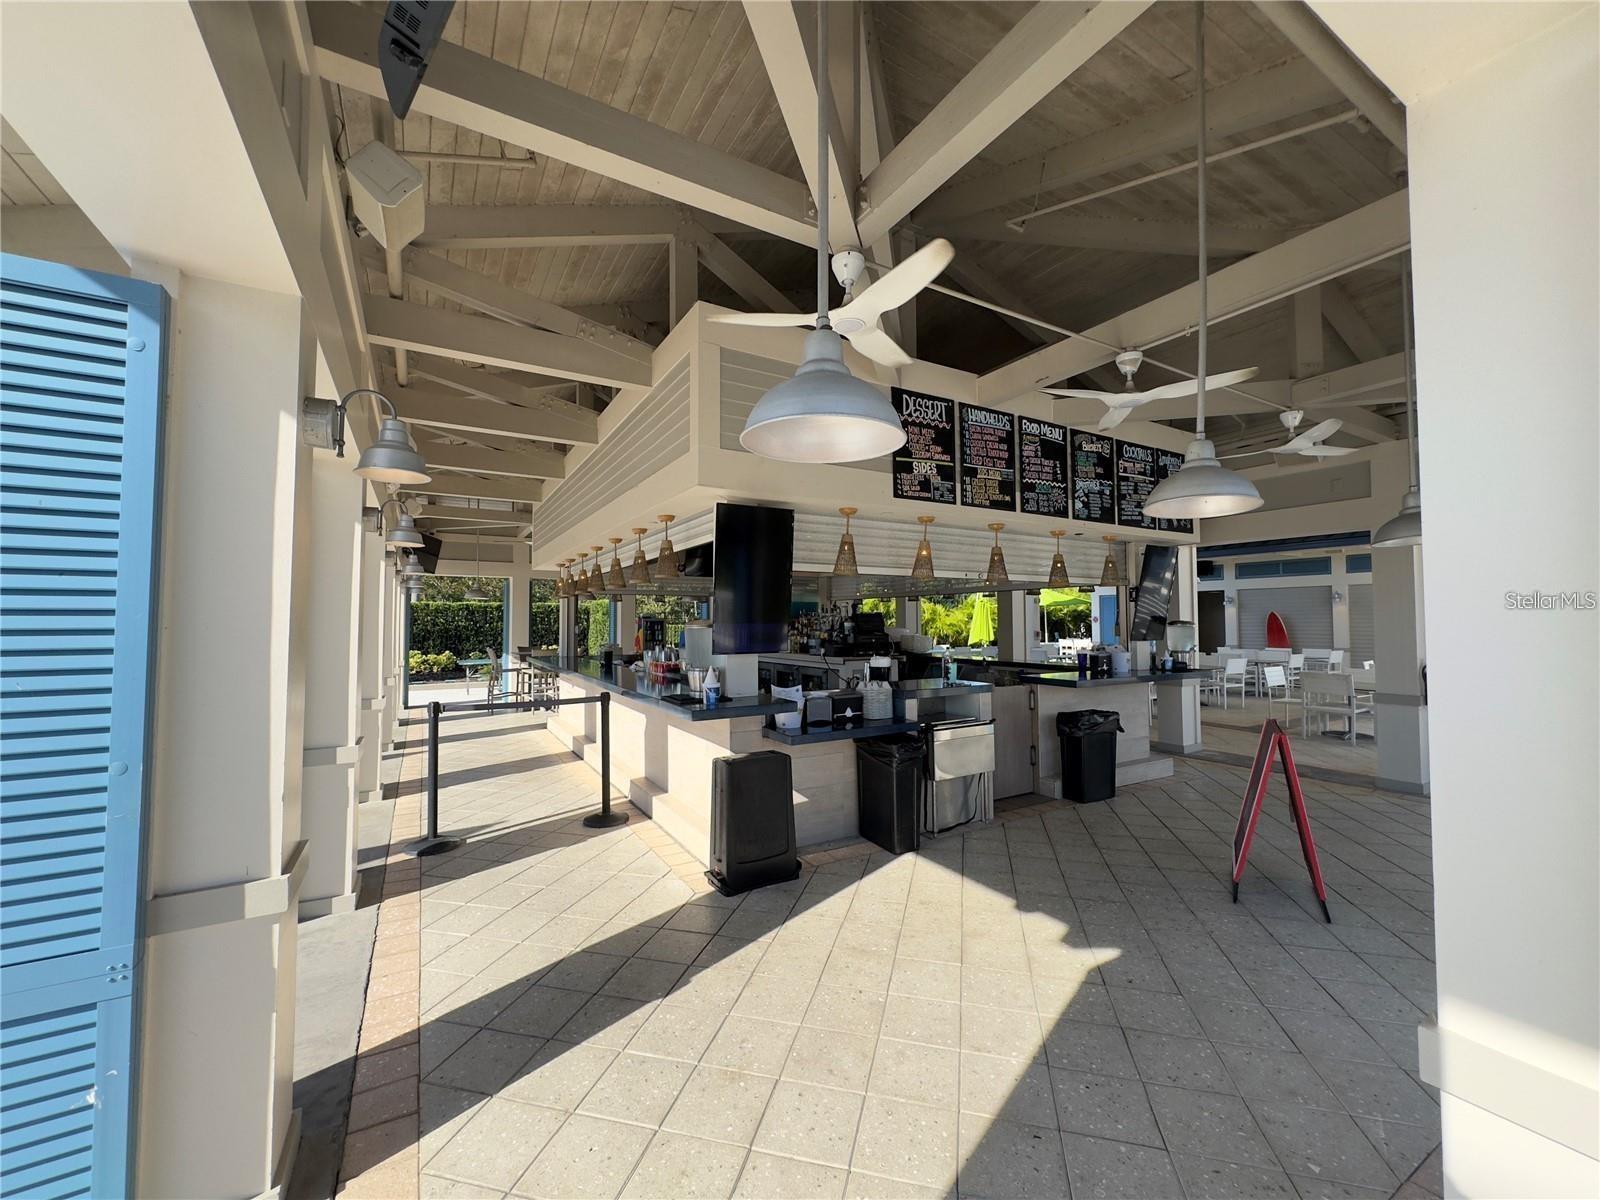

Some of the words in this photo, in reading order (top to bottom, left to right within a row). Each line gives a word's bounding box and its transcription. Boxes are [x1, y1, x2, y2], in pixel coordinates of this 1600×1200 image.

[902, 394, 948, 422] DESSERT
[968, 408, 1010, 430] HANDHELDS
[1022, 420, 1040, 434] FOOD
[1040, 423, 1062, 441] MENU
[1123, 444, 1152, 462] COCKTAILS
[912, 462, 938, 474] SIDES
